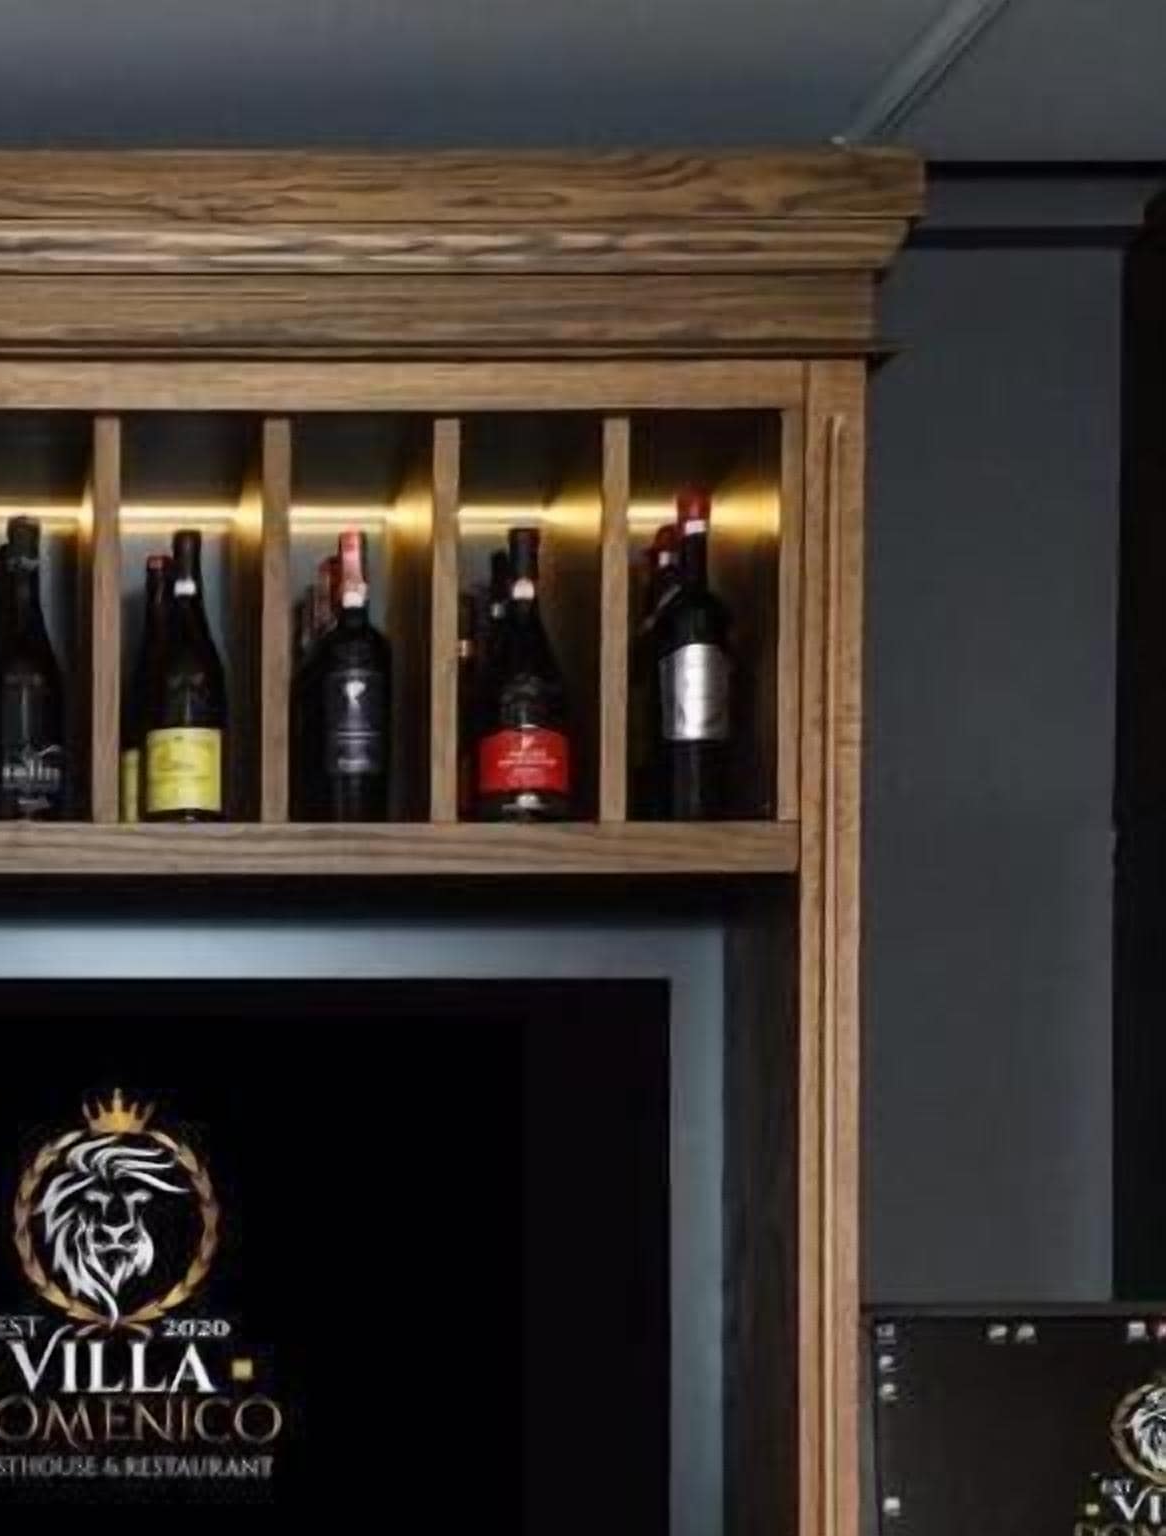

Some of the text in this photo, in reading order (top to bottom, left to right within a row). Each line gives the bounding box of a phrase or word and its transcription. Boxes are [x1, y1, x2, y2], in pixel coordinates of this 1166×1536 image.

[162, 1319, 232, 1337] 2020
[8, 1325, 218, 1393] VILLA
[123, 1455, 274, 1477] RESTAURANT
